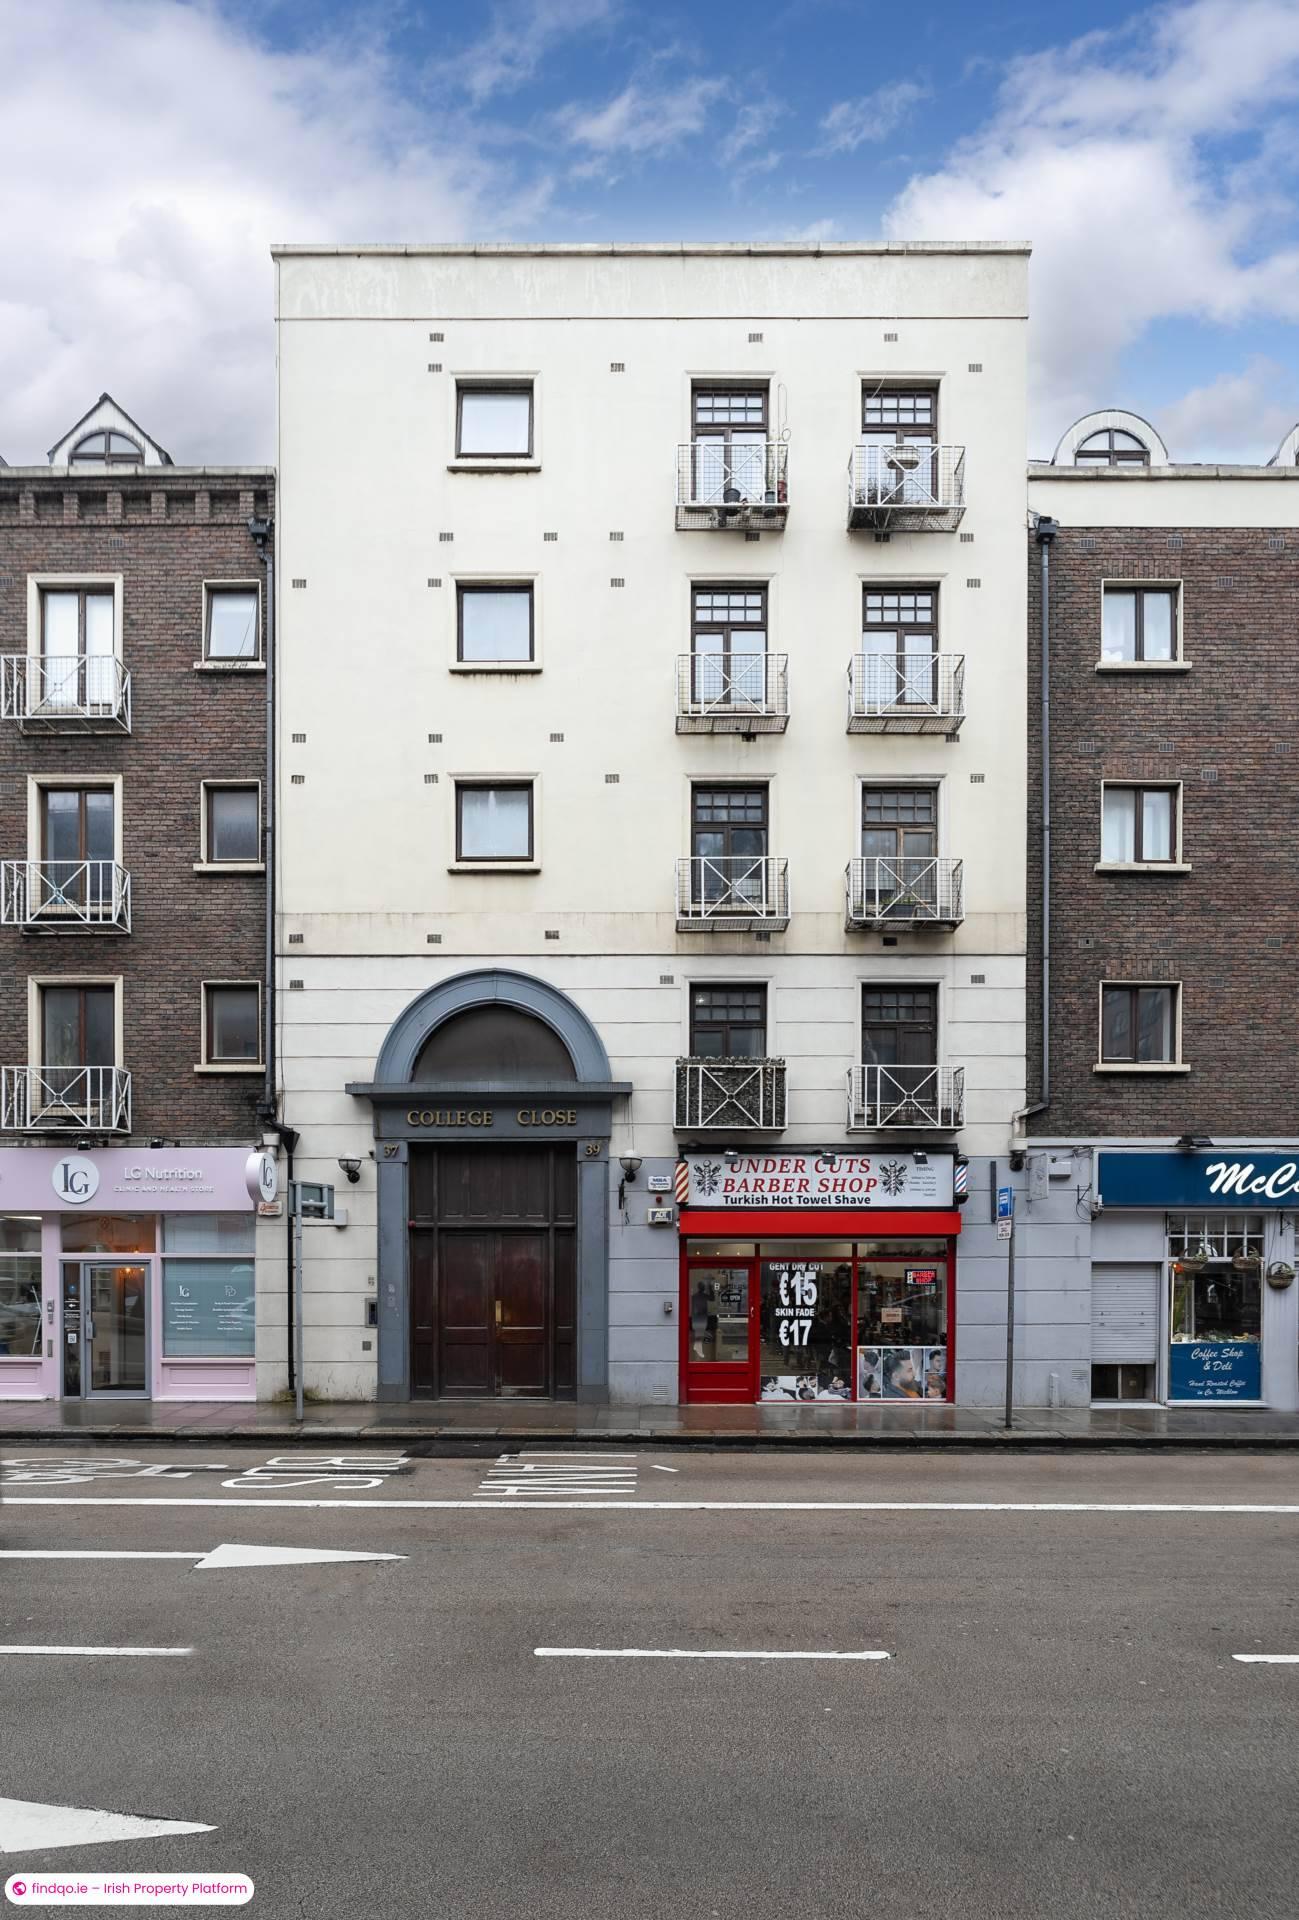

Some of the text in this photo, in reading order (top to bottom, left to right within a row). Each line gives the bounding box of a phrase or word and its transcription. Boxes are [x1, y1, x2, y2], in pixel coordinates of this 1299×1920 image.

[407, 1109, 577, 1126] COLLEGE CLOSE
[383, 1144, 400, 1157] 37
[585, 1143, 601, 1156] 39
[145, 1167, 202, 1180] Nutrition
[262, 1158, 273, 1189] LG
[730, 1158, 871, 1174] UNDER CUTS
[61, 1163, 89, 1195] LG
[721, 1178, 878, 1193] BARBER SHOP
[723, 1194, 871, 1205] Turkish Hot Towel Shave
[769, 1262, 825, 1271] GENT DRY CUT
[779, 1271, 818, 1306] €15
[775, 1308, 815, 1317] SKIN FADE
[778, 1319, 813, 1346] €17
[1190, 1346, 1245, 1361] Coffee Shop
[1202, 1360, 1233, 1371] & Deli
[220, 1456, 412, 1490] BUS
